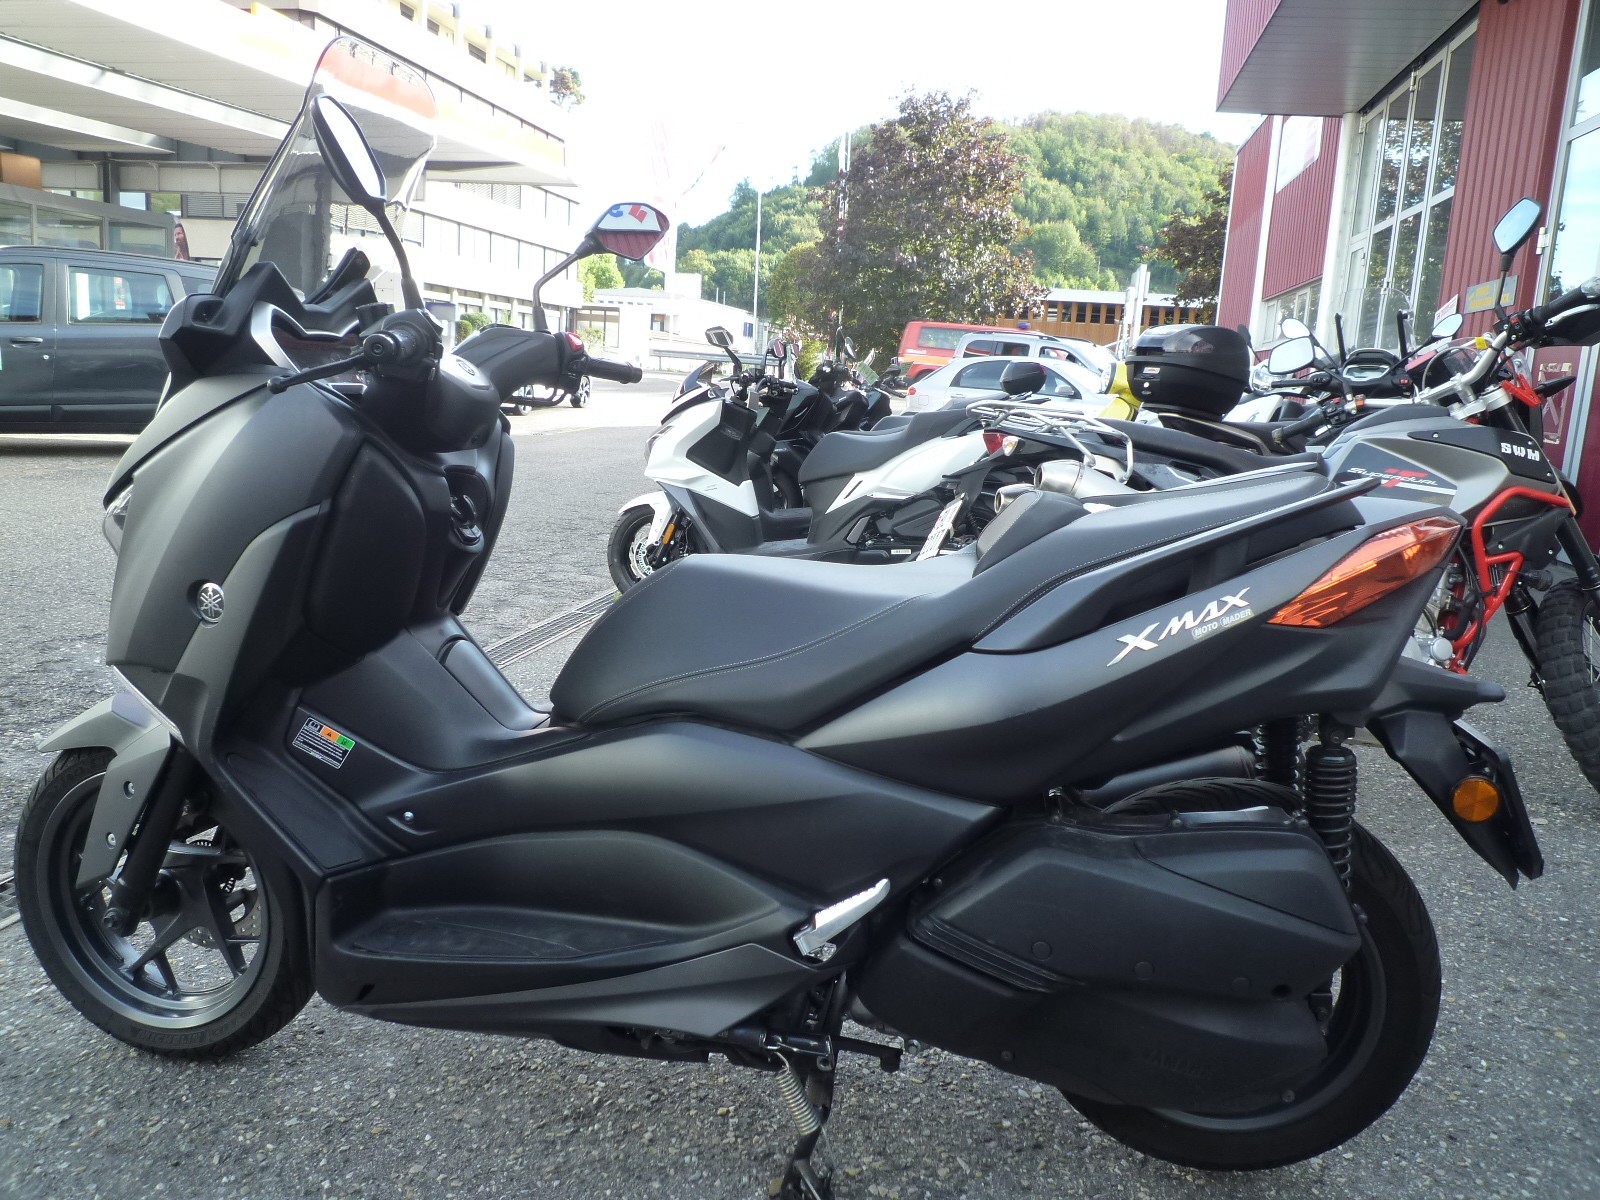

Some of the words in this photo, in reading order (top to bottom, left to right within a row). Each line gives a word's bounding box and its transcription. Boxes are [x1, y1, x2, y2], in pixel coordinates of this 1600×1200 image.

[1500, 442, 1540, 462] SWM
[1192, 621, 1218, 638] MOTO
[1220, 608, 1251, 627] MADER
